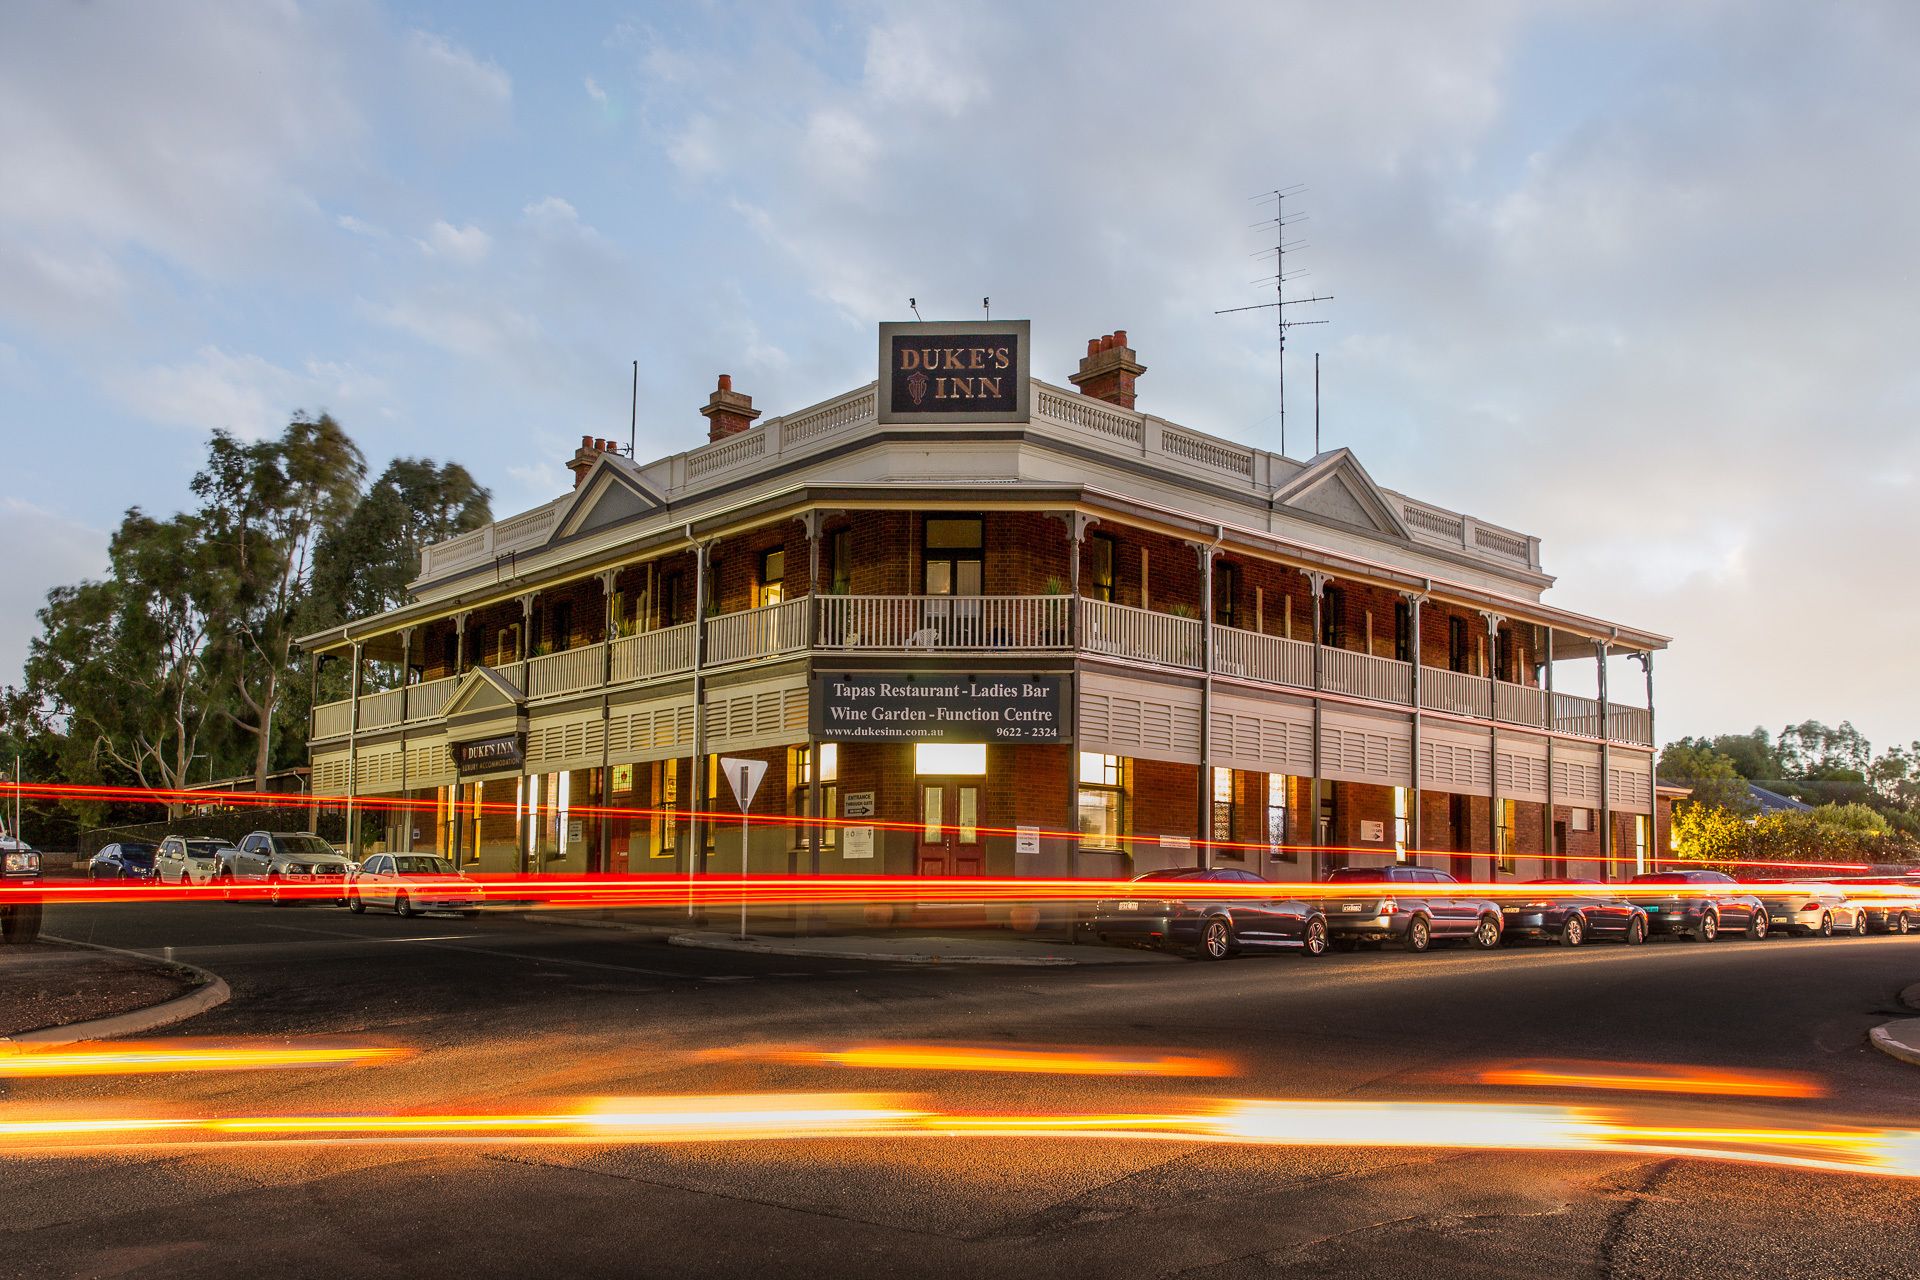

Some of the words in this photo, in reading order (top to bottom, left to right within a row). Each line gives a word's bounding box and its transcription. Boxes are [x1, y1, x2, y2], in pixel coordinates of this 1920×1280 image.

[900, 347, 1009, 370] DUKE'S
[935, 377, 1002, 399] INN
[833, 683, 876, 700] Tapas
[880, 683, 960, 697] Restaurant
[970, 683, 1018, 698] Ladies
[1022, 684, 1050, 698] Bar
[830, 706, 867, 721] Wine
[871, 706, 926, 721] Garden
[936, 706, 999, 721] Function
[1004, 707, 1052, 722] Centre
[825, 727, 944, 736] www.dukesinn.com.au
[468, 744, 495, 759] DUKE'S
[497, 741, 513, 754] INN
